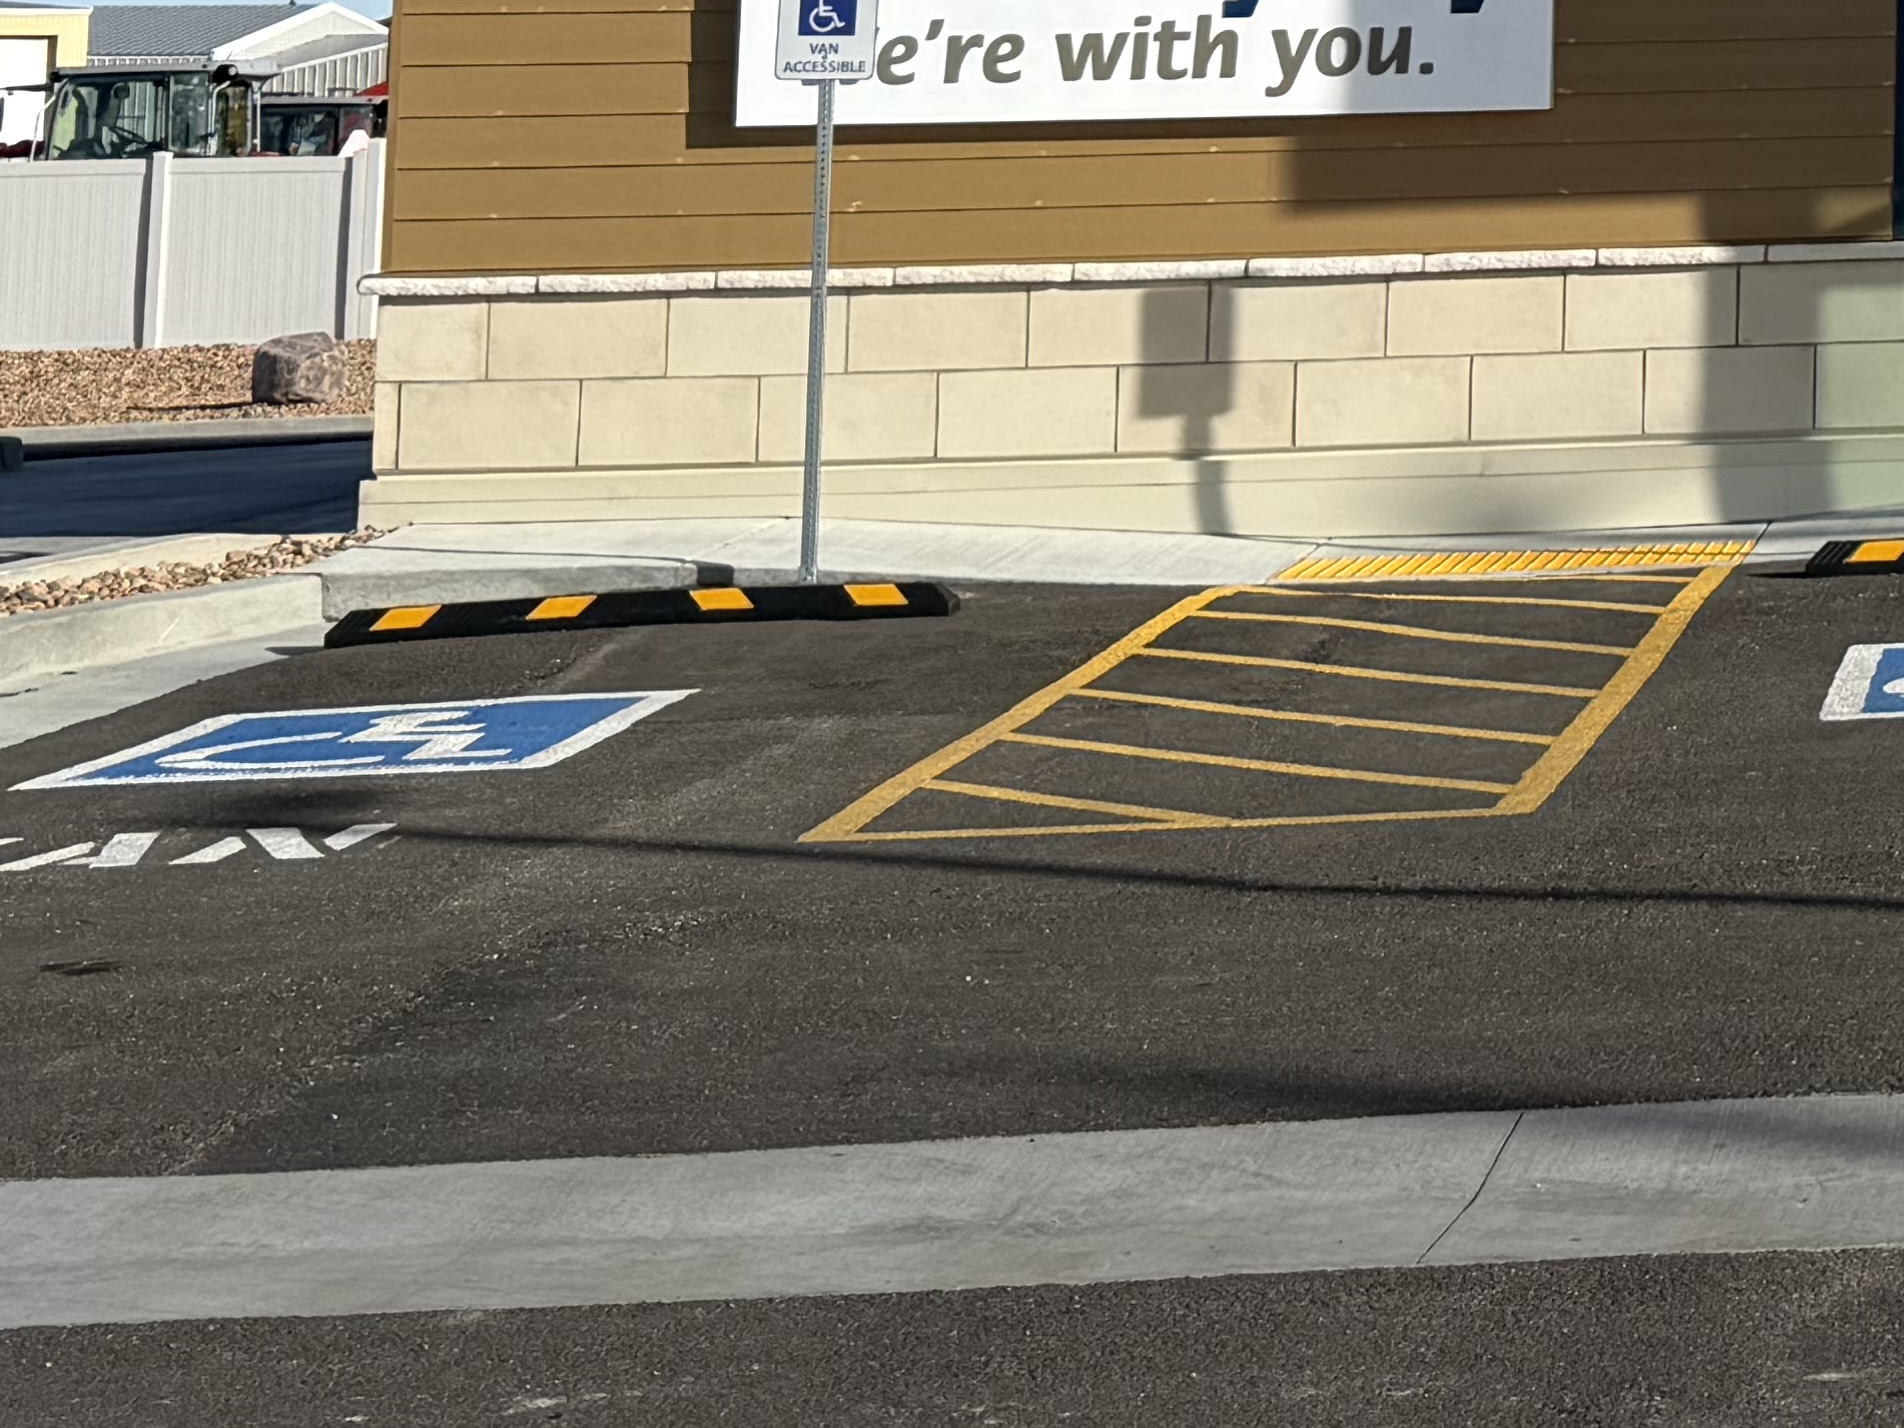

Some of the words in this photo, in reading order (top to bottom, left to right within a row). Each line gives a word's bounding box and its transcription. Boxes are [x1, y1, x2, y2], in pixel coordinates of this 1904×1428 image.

[809, 43, 839, 55] VAN
[876, 18, 1023, 86] e're
[1057, 14, 1238, 81] with
[1265, 25, 1436, 97] you.
[783, 61, 866, 73] ACCESSIBLE
